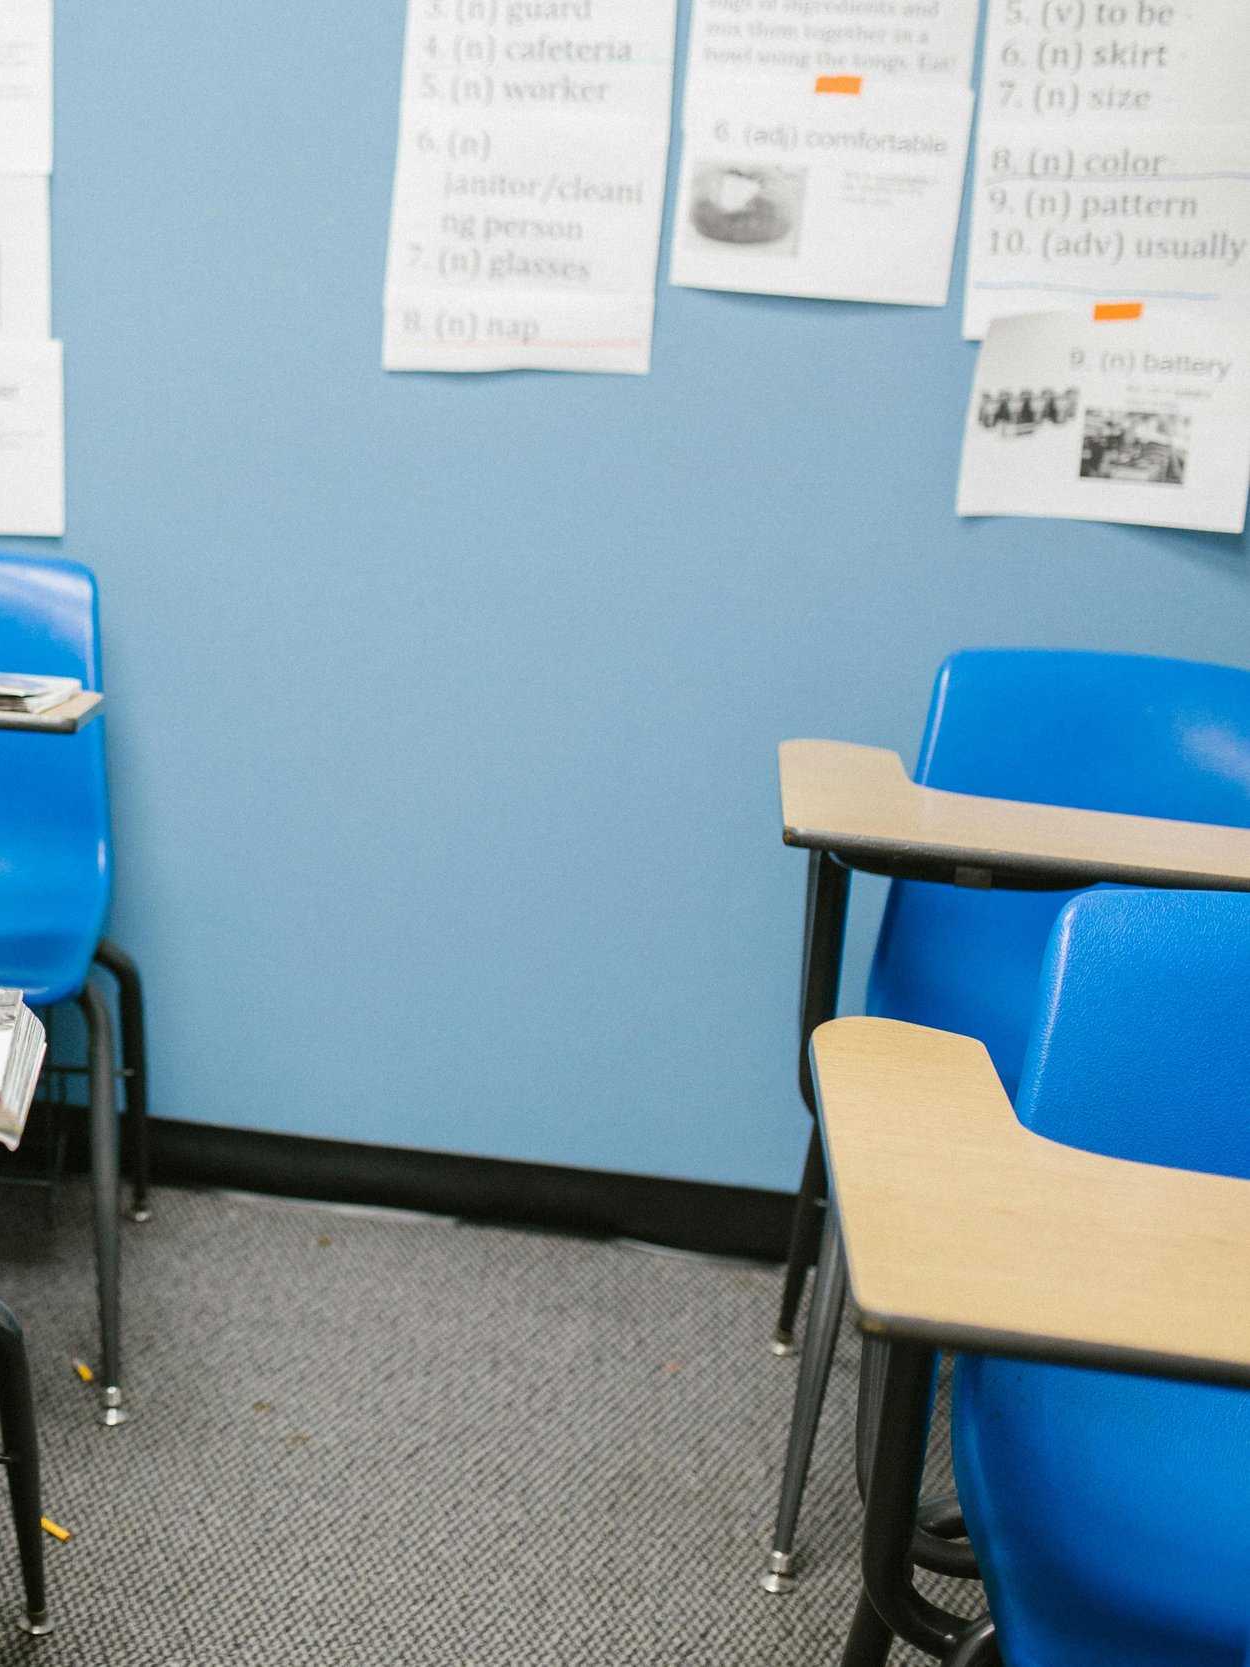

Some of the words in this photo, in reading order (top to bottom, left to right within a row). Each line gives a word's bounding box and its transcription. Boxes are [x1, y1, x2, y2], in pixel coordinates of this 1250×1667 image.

[505, 0, 593, 26] guard
[902, 0, 940, 19] and
[1004, 0, 1031, 26] 5.
[1041, 0, 1085, 32] (v)
[1095, 1, 1127, 26] to
[1137, 0, 1175, 27] be
[452, 33, 497, 68] (n)
[503, 33, 633, 64] cafeteria
[803, 22, 887, 46] together
[756, 50, 810, 70] using
[1000, 36, 1027, 68] 6.
[1036, 38, 1083, 75] (n)
[1092, 38, 1168, 69] skirt
[450, 72, 495, 107] (n)
[502, 73, 612, 102] worker
[998, 79, 1024, 109] 7.
[1034, 80, 1080, 117] (n)
[1089, 81, 1152, 111] size
[447, 127, 492, 163] (n)
[804, 126, 948, 157] comfortable
[990, 146, 1019, 176] 8.
[1027, 147, 1075, 181] (n)
[1083, 146, 1168, 179] color
[443, 170, 644, 206] janitor/cleani
[987, 187, 1016, 215] 9.
[1024, 187, 1072, 224] (n)
[1080, 193, 1199, 224] pattern
[441, 213, 477, 240] ng
[483, 215, 584, 243] person
[437, 246, 482, 280] (n)
[487, 249, 592, 283] glasses
[988, 227, 1032, 257] 10.
[1040, 227, 1125, 267] (adv)
[1135, 230, 1248, 268] usually
[434, 308, 479, 344] (n)
[486, 316, 541, 346] nap
[1100, 348, 1137, 377] (n)
[1143, 350, 1233, 384] battery
